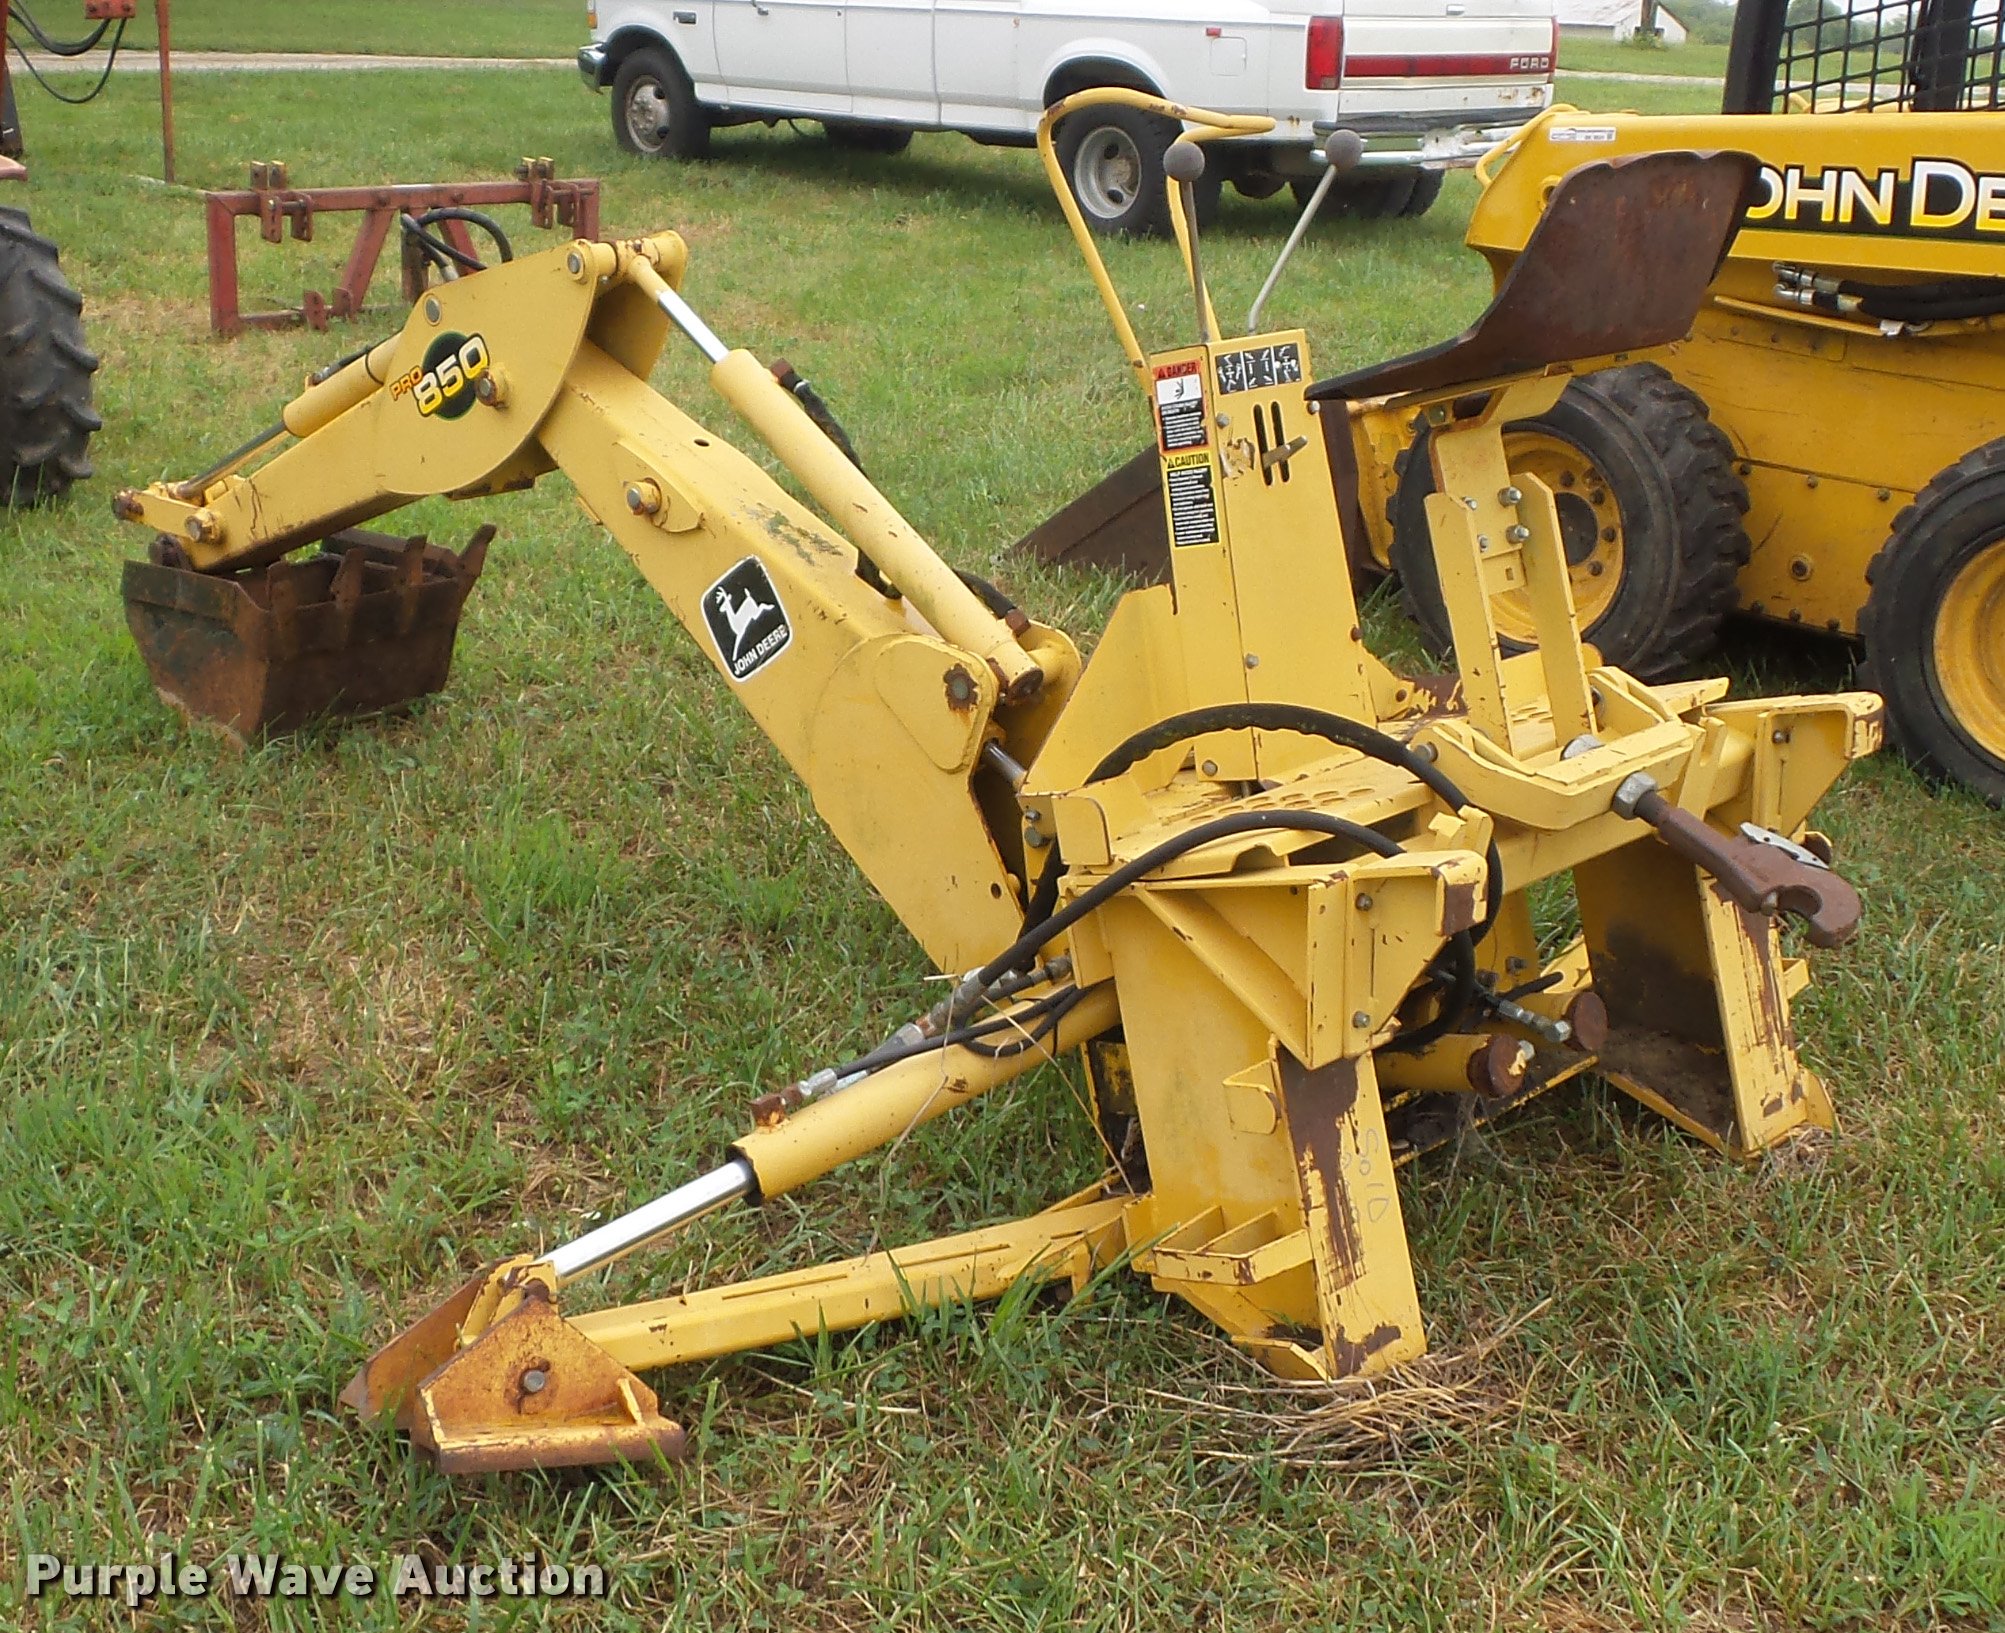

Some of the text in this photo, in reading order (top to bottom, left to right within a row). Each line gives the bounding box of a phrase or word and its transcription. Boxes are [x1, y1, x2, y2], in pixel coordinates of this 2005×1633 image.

[1509, 56, 1549, 70] FORD
[1746, 165, 1895, 226] OHN
[389, 333, 490, 417] PRO 850
[1167, 361, 1197, 378] DANGER
[1174, 453, 1210, 467] CAUTION
[733, 623, 788, 676] JOHN DEERE
